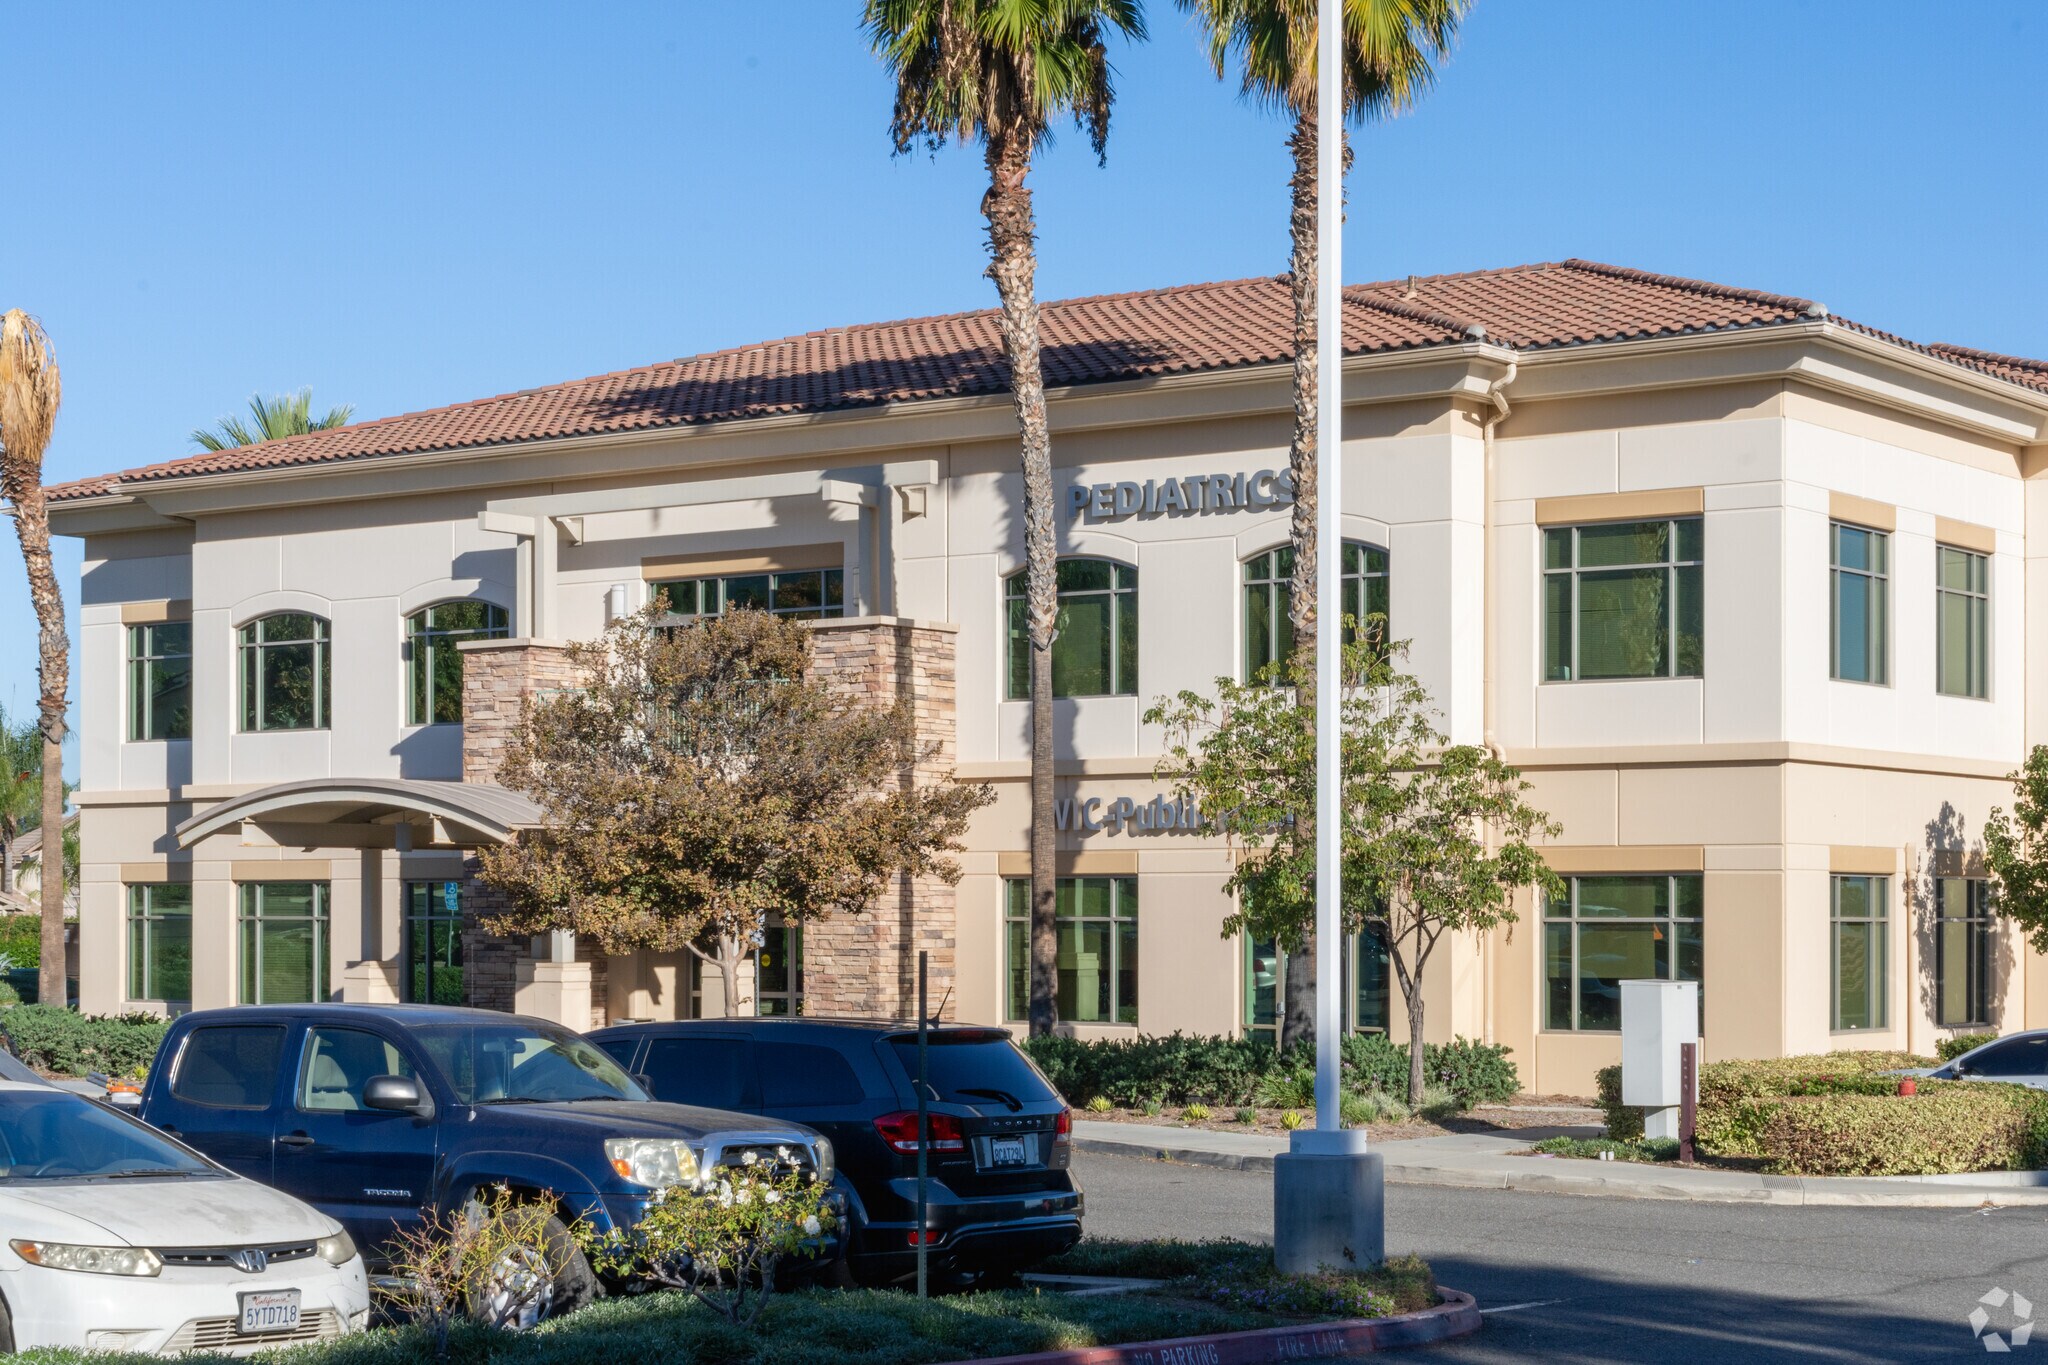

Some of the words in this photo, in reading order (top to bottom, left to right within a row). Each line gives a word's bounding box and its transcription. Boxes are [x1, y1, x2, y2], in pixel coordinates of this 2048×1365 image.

[1067, 468, 1293, 519] PEDIATRICS
[246, 1305, 298, 1326] 5YTD718
[1160, 1344, 1219, 1365] PARKING
